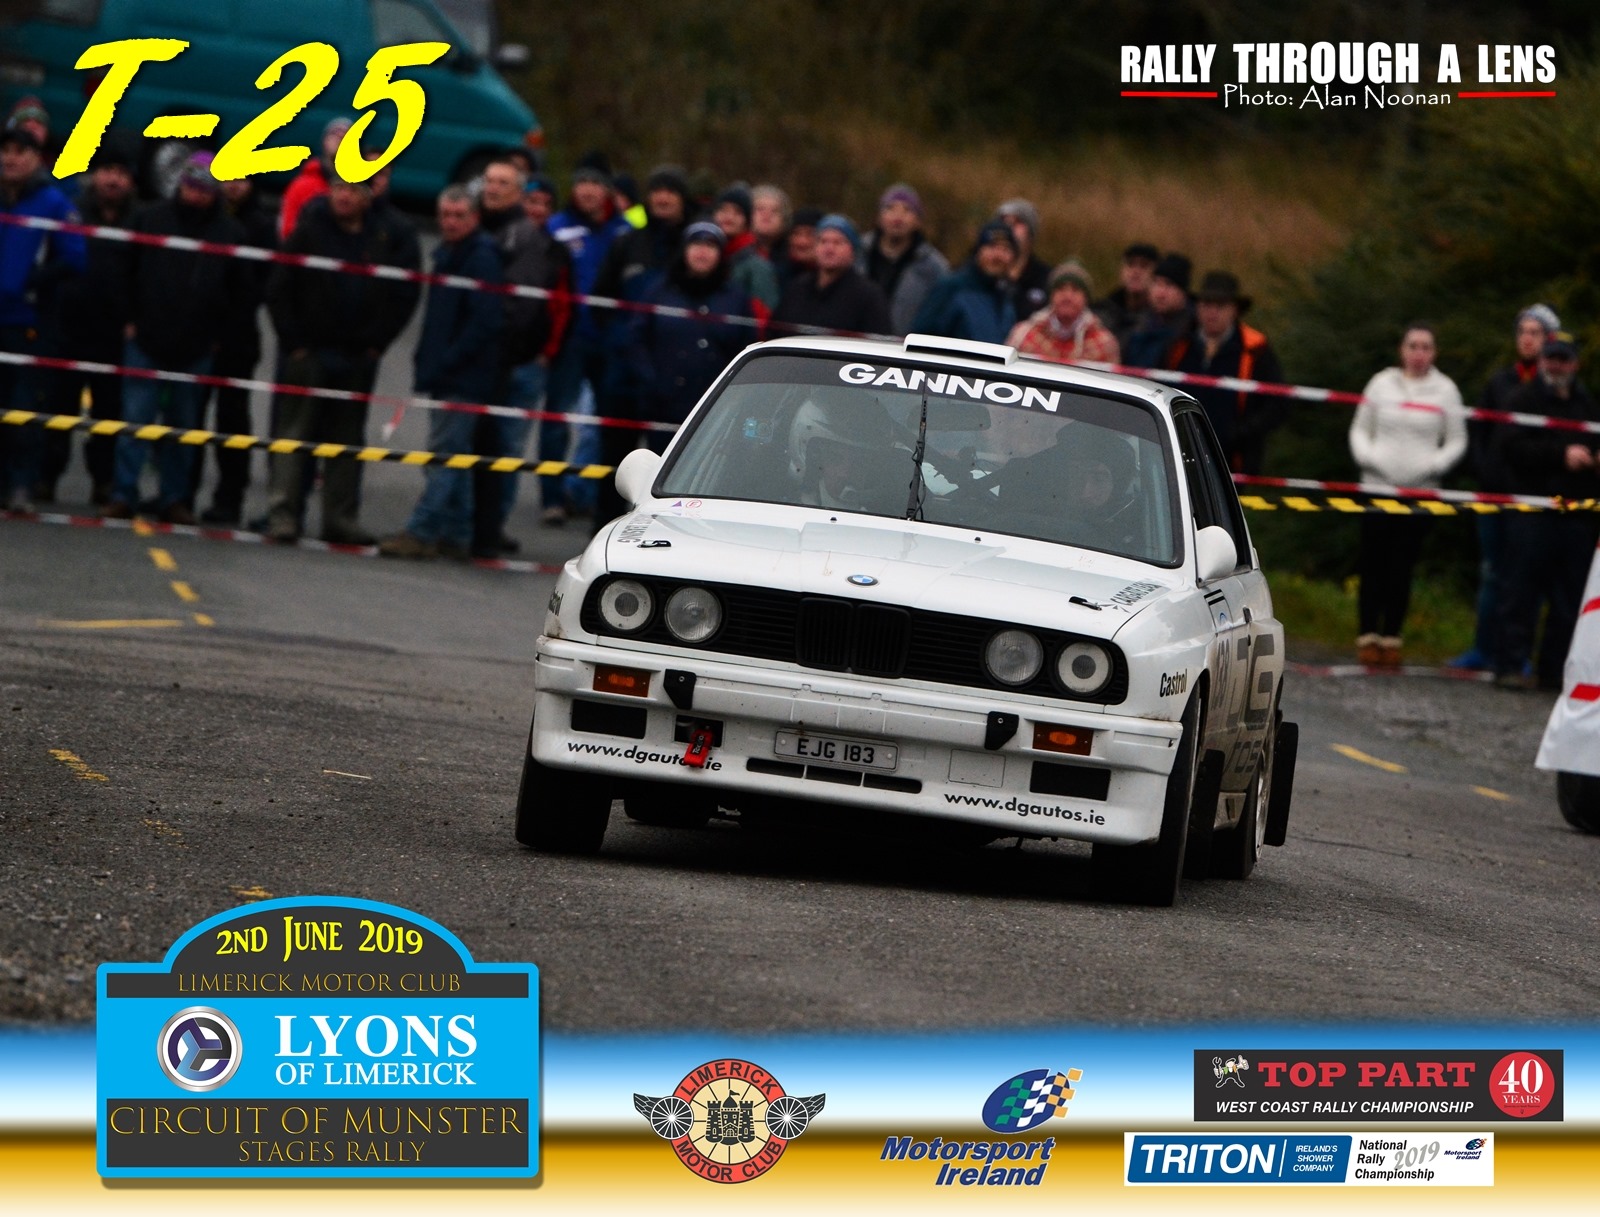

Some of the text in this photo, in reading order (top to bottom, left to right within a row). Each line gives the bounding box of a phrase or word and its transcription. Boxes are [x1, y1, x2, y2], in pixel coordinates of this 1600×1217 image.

[839, 363, 1061, 412] GANNON
[1160, 668, 1187, 698] Castrol
[568, 743, 722, 771] www.dgautoie
[797, 738, 874, 764] EJG 183
[944, 793, 1105, 825] www.dgautos.ie
